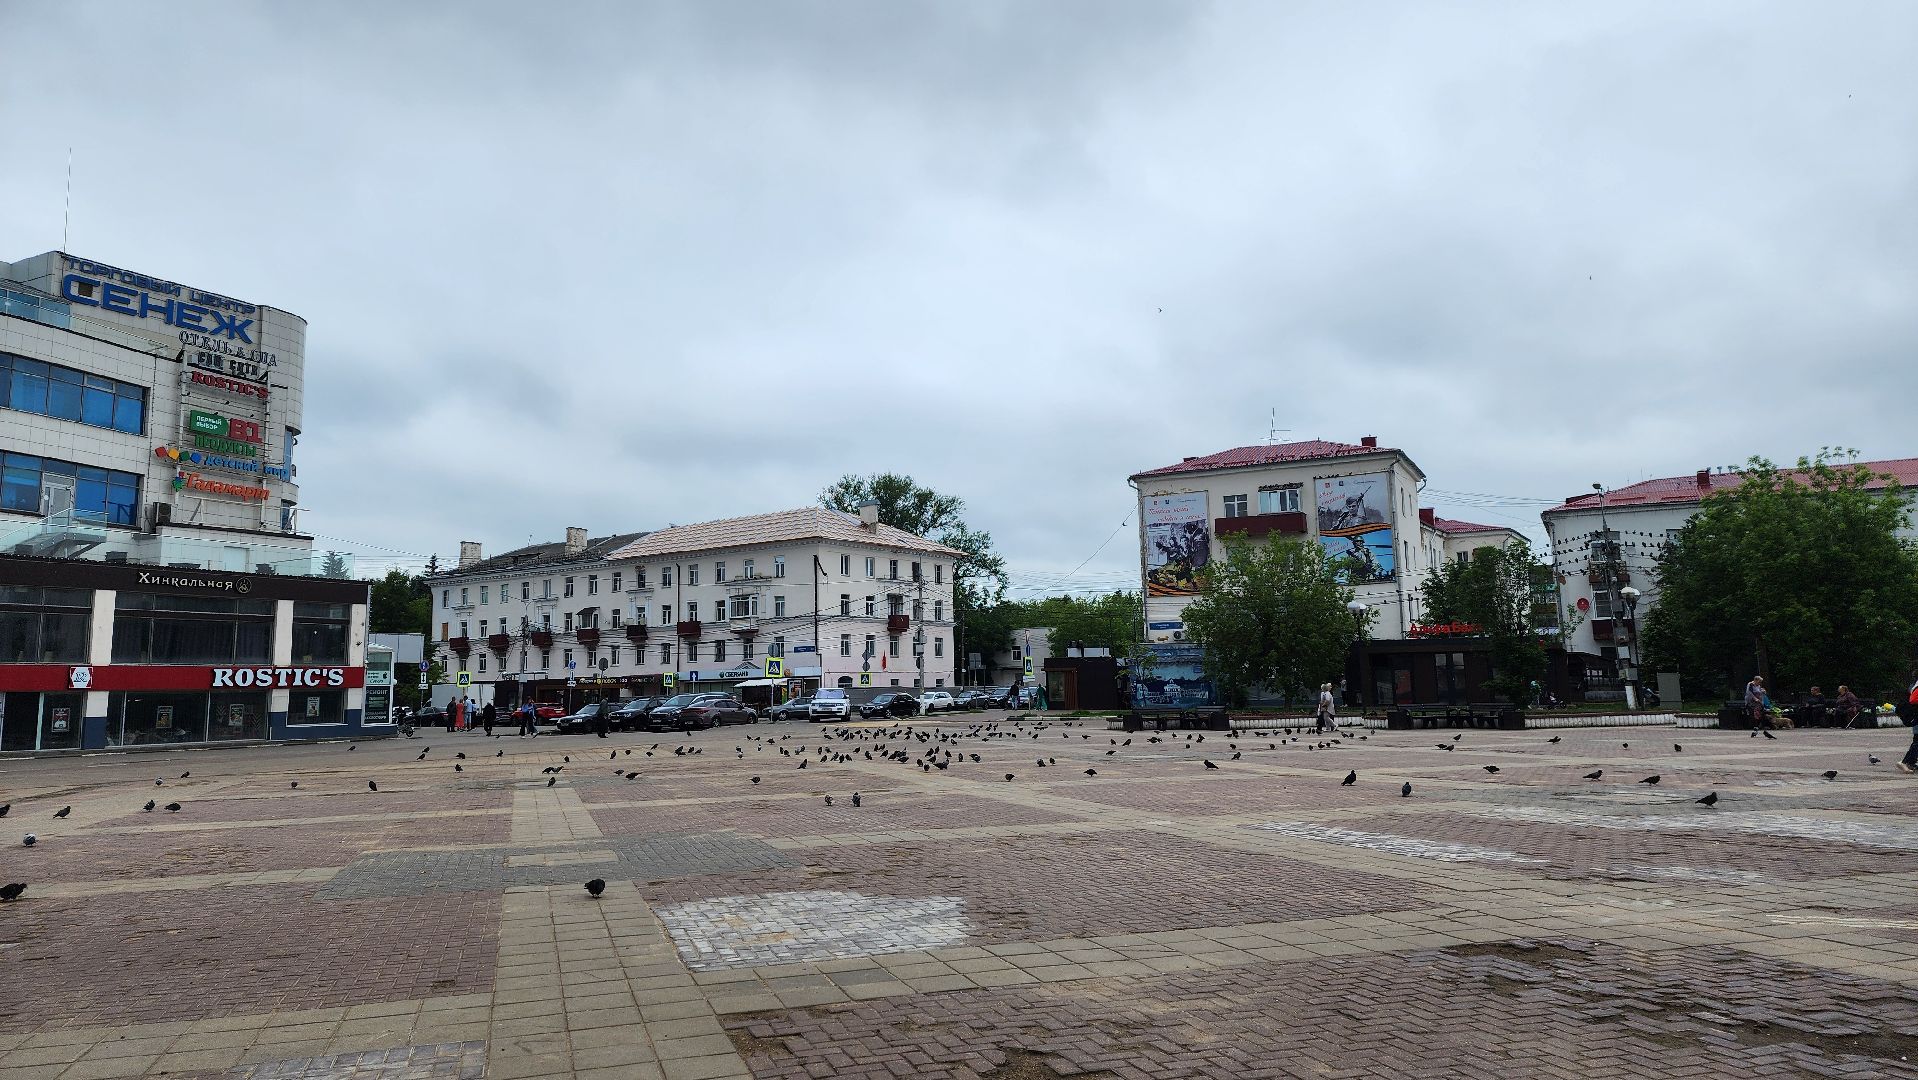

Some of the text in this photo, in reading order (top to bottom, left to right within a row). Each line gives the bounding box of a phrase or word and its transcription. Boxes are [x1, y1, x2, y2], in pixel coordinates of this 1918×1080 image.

[66, 257, 256, 315] ТОРГОВЫЙ ЦЕНТР
[62, 273, 255, 345] СЕНЕЖ
[190, 370, 270, 400] ROSTIC'S
[138, 572, 234, 591] Хинкальная
[212, 667, 345, 688] ROSTIC'S
